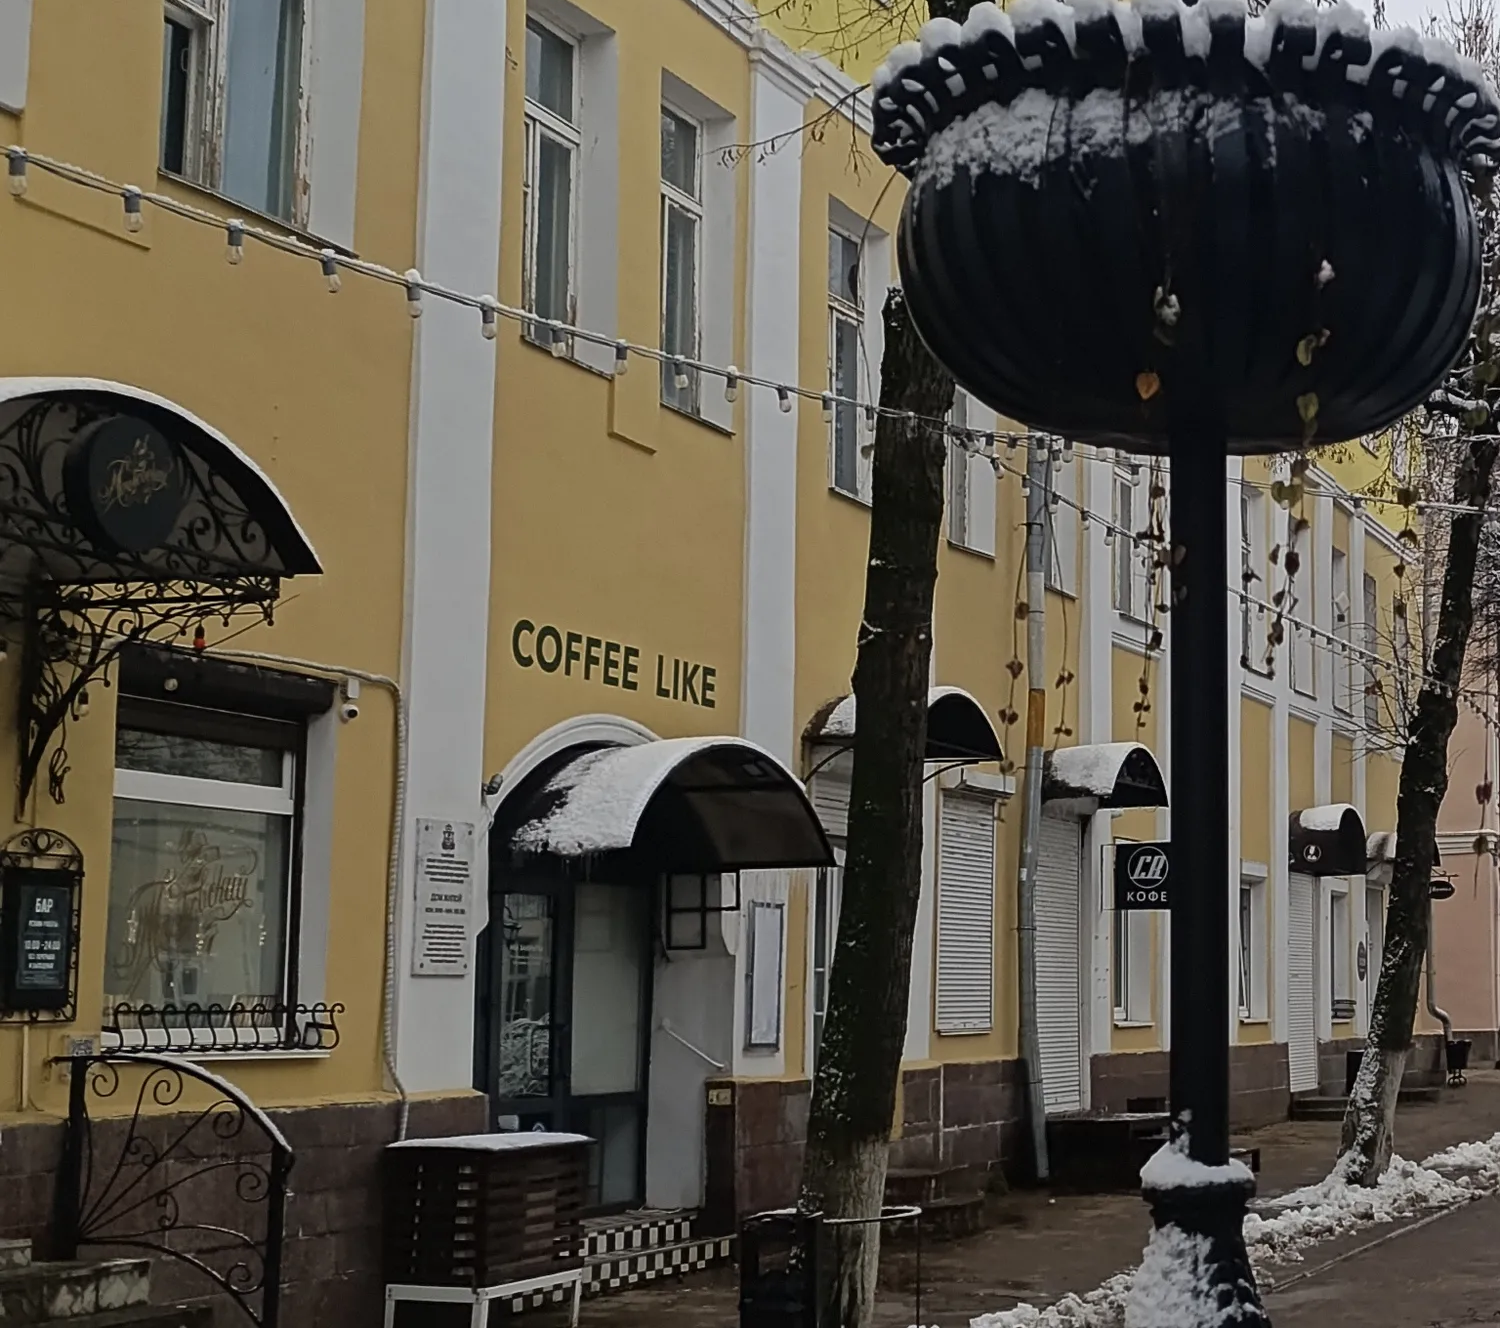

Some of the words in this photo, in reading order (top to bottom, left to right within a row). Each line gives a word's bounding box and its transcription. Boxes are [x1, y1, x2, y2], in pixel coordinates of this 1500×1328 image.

[512, 619, 640, 691] COFFEE
[655, 655, 717, 708] LIKE
[1127, 891, 1168, 902] КОФЕ
[35, 897, 54, 913] БАР
